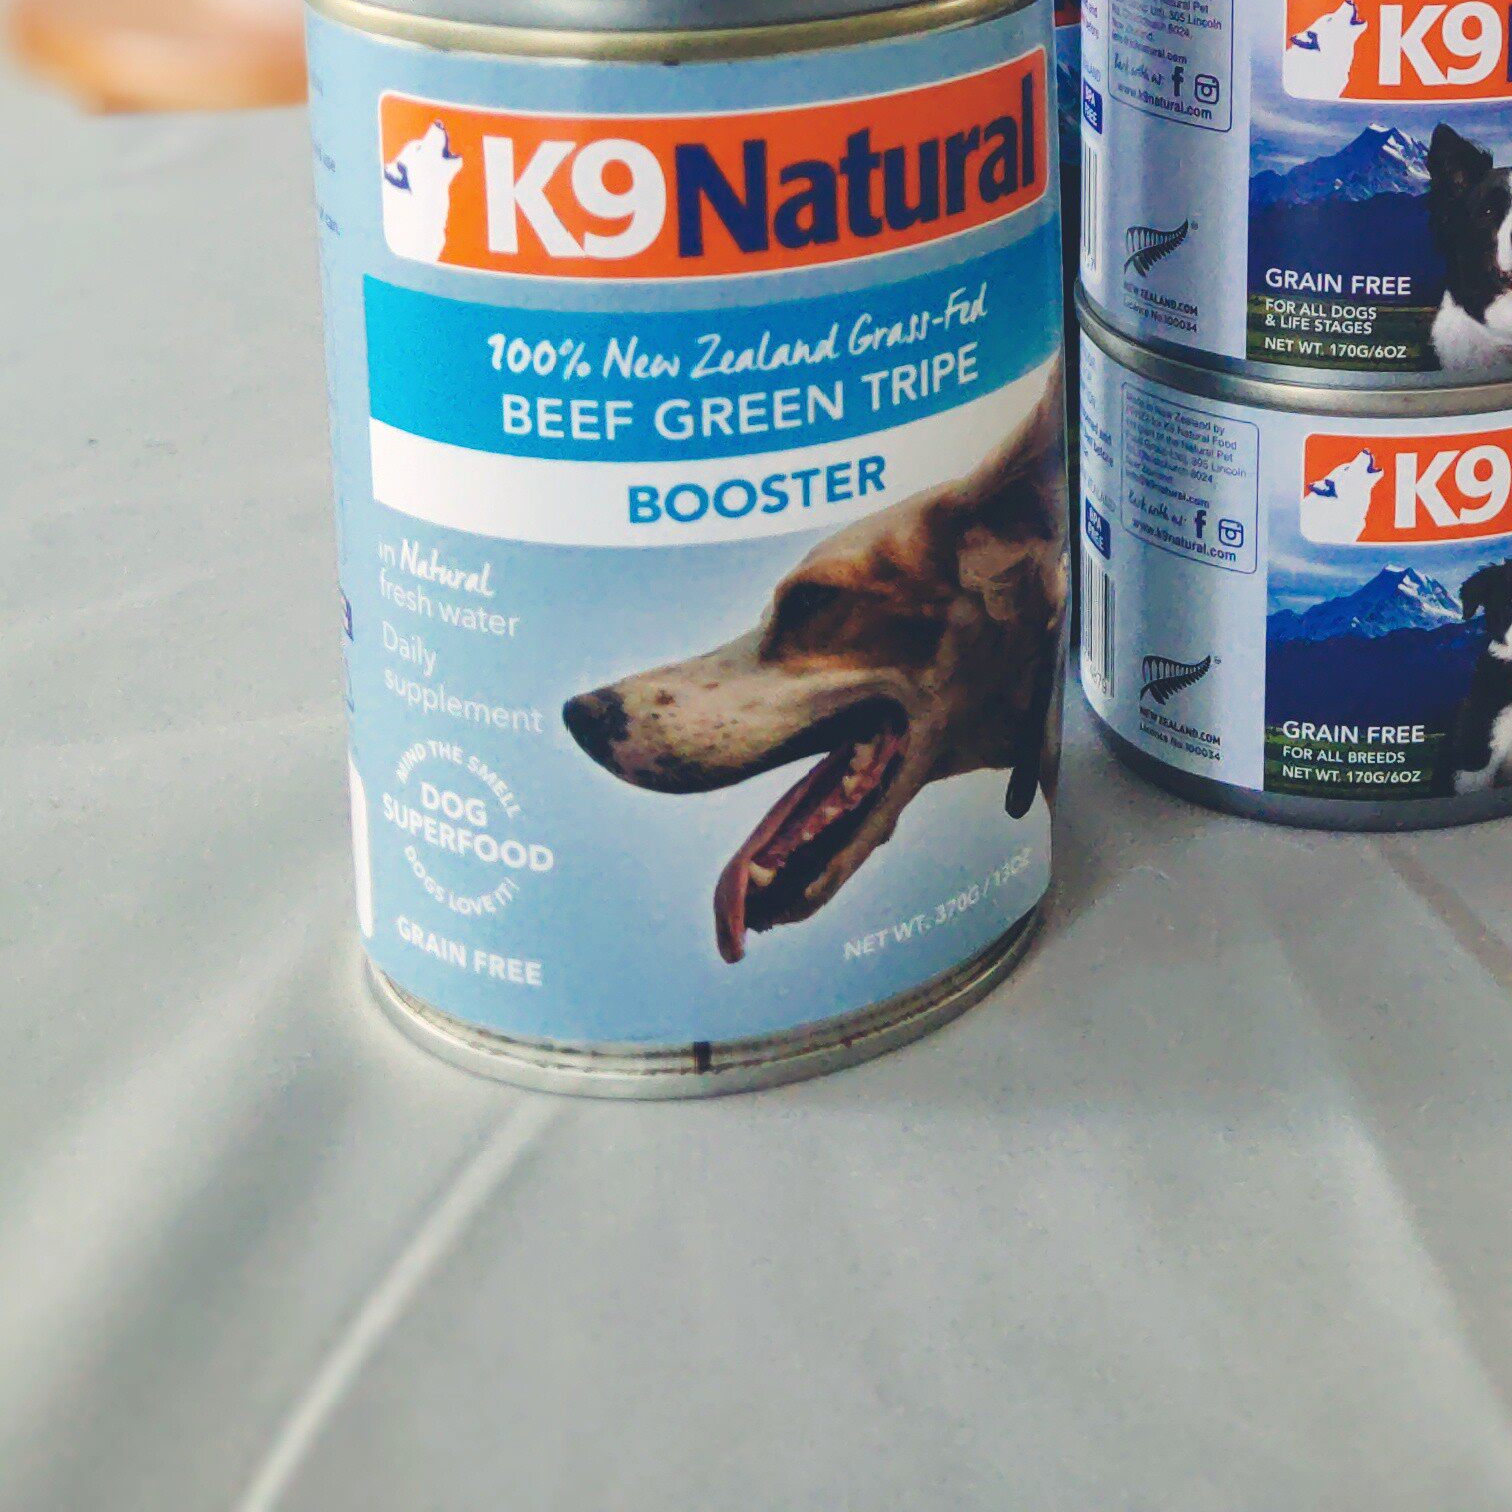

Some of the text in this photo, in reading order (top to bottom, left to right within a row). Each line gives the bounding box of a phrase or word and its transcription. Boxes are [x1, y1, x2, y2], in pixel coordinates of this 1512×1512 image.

[1264, 267, 1411, 296] GRAIN FREE
[1265, 298, 1377, 320] FOR ALL DOGS
[486, 281, 989, 381] 100% New Zealand Grass-Fed
[1264, 313, 1373, 335] & LIFE STAGES
[1264, 337, 1407, 359] NET WT. 170G/6OZ
[502, 341, 979, 442] BEEF GREEN TRIPE
[1212, 435, 1237, 450] Food
[1216, 450, 1233, 463] Pet
[1211, 462, 1247, 478] Lincoln
[627, 454, 886, 524] BOOSTER
[400, 537, 495, 598] Natural
[379, 566, 521, 637] fresh water
[382, 619, 437, 678] Daily
[384, 667, 544, 734] supplement
[1282, 720, 1425, 744] GRAIN FREE
[427, 738, 464, 765] THE
[1185, 743, 1221, 761] 100034
[1282, 745, 1406, 764] FOR ALL BREEDS
[1282, 765, 1422, 784] NET WT. 170G/6OZ
[421, 781, 488, 828] DOG
[382, 791, 554, 873] SUPERFOOD
[396, 915, 545, 988] GRAIN FREE
[843, 928, 890, 960] NET
